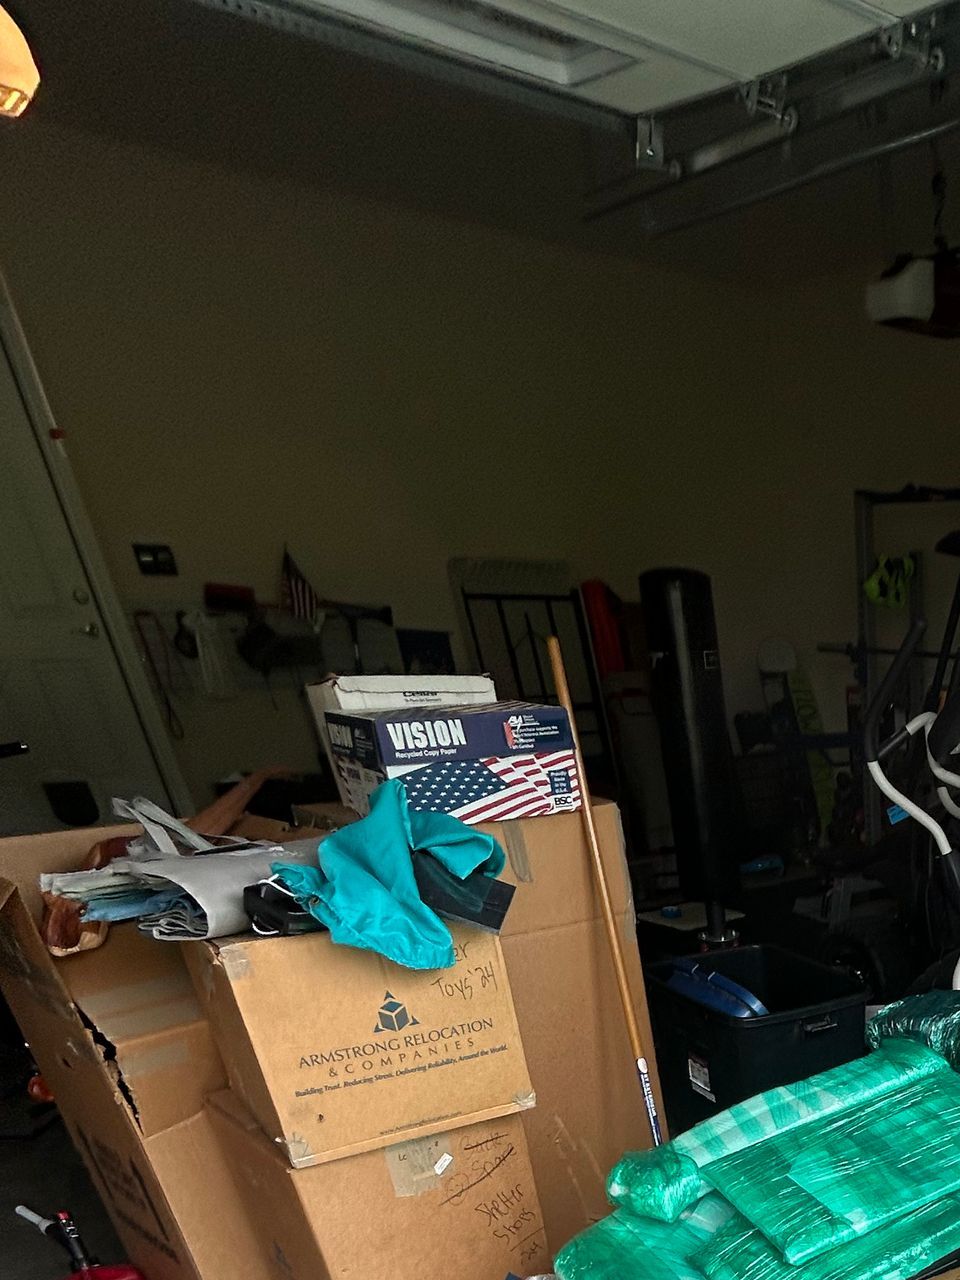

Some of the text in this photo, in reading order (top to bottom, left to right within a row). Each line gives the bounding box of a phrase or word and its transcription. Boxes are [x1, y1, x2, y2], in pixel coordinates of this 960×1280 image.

[386, 719, 467, 751] VISION
[395, 750, 423, 759] Recycled
[424, 748, 439, 757] Copy
[430, 976, 473, 1001] Toys
[299, 1018, 493, 1069] ARMSTRONG RELOCATION
[328, 1037, 475, 1077] & COMPANIES
[295, 1086, 324, 1098] Building
[343, 1076, 374, 1088] Reducing
[395, 1064, 428, 1077] Delivering
[459, 1051, 480, 1061] Around
[480, 1049, 489, 1057] the
